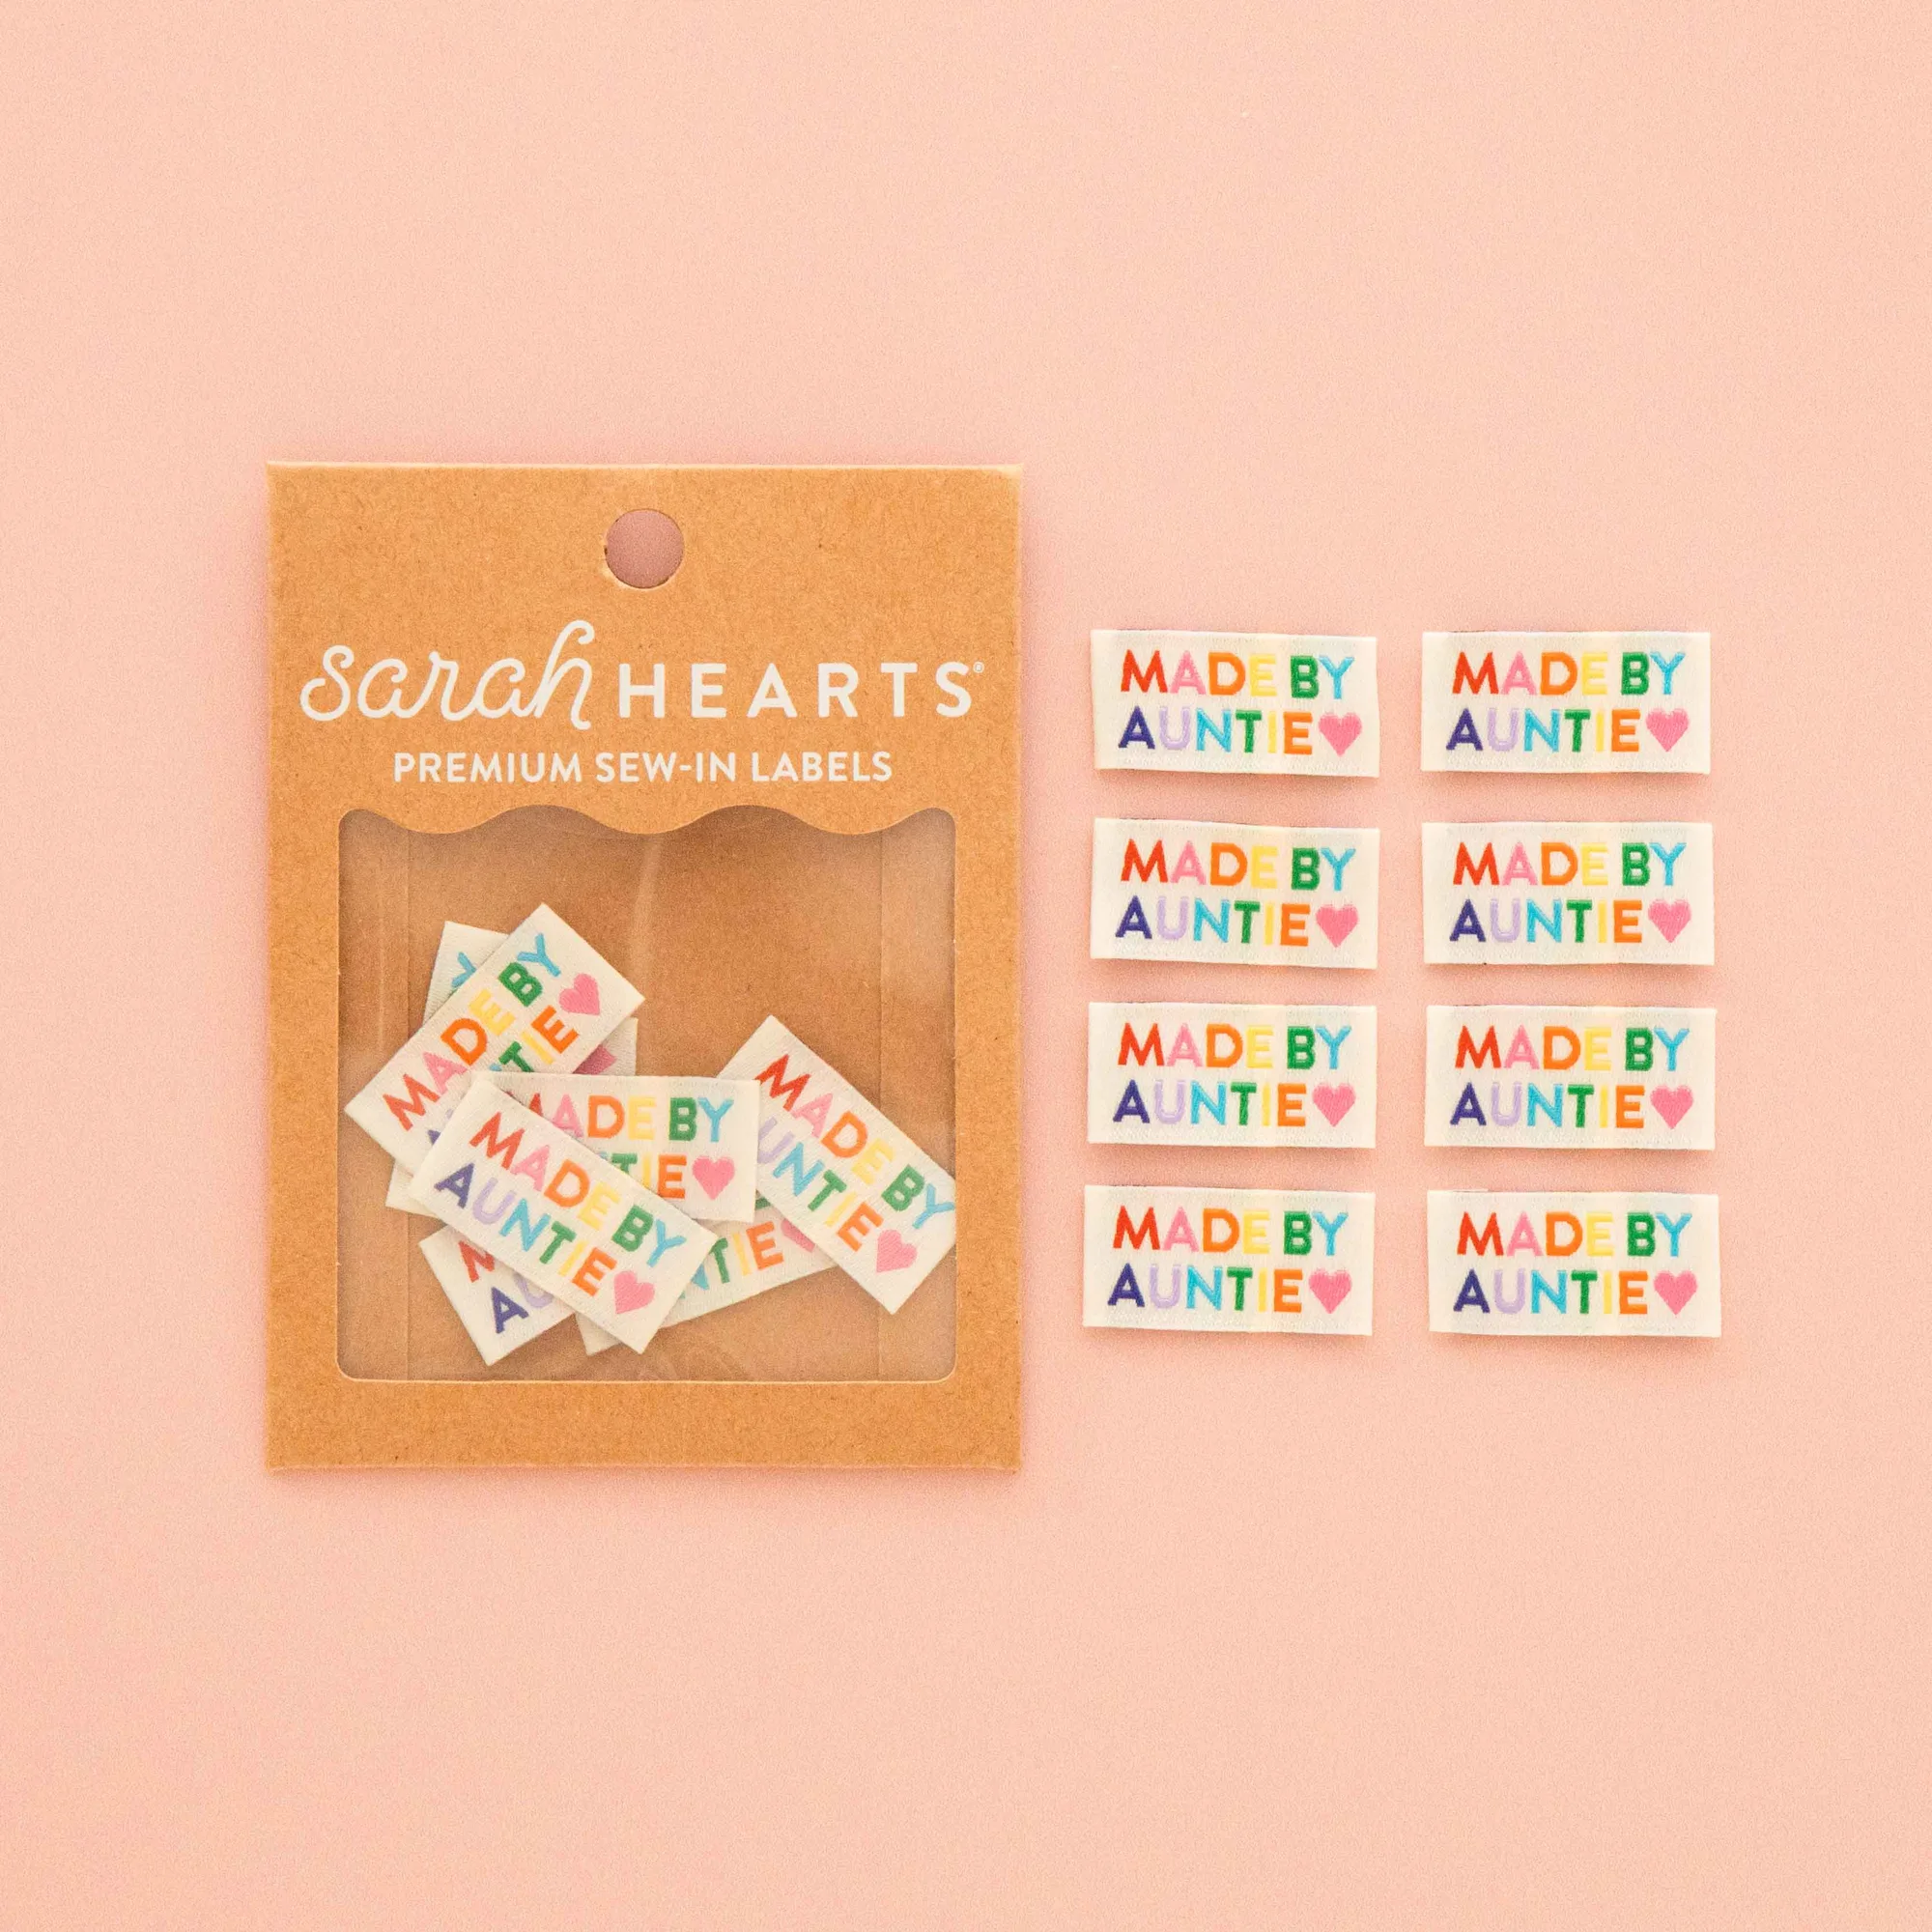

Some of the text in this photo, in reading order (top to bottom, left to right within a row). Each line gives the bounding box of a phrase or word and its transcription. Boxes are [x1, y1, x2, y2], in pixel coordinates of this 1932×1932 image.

[1120, 649, 1354, 699] MADE BY
[1451, 650, 1686, 696] MADE BY
[1118, 706, 1313, 754] AUNTIE
[1446, 707, 1640, 753] AUNTIE
[393, 752, 893, 782] PREMIUM SEW-IN LABELS
[1120, 838, 1356, 891] MADE BY
[1453, 841, 1687, 887] MADE BY
[1116, 895, 1310, 947] AUNTIE
[1449, 899, 1642, 943] AUNTIE
[383, 933, 560, 1131] MADE BY
[1117, 1022, 1351, 1069] MADE BY
[1455, 1025, 1690, 1071] MADE BY
[668, 1097, 735, 1144] BY
[1113, 1080, 1306, 1126] AUNTIE
[1450, 1080, 1645, 1128] AUNTIE
[753, 1054, 955, 1230] MADE BY
[469, 1112, 687, 1268] MADE BY
[757, 1117, 885, 1253] UNTIE
[434, 1163, 618, 1297] AUNTIE
[1113, 1206, 1349, 1256] MADE BY
[1457, 1211, 1692, 1257] MADE BY
[1107, 1264, 1302, 1314] AUNTIE
[1453, 1268, 1648, 1314] AUNTIE
